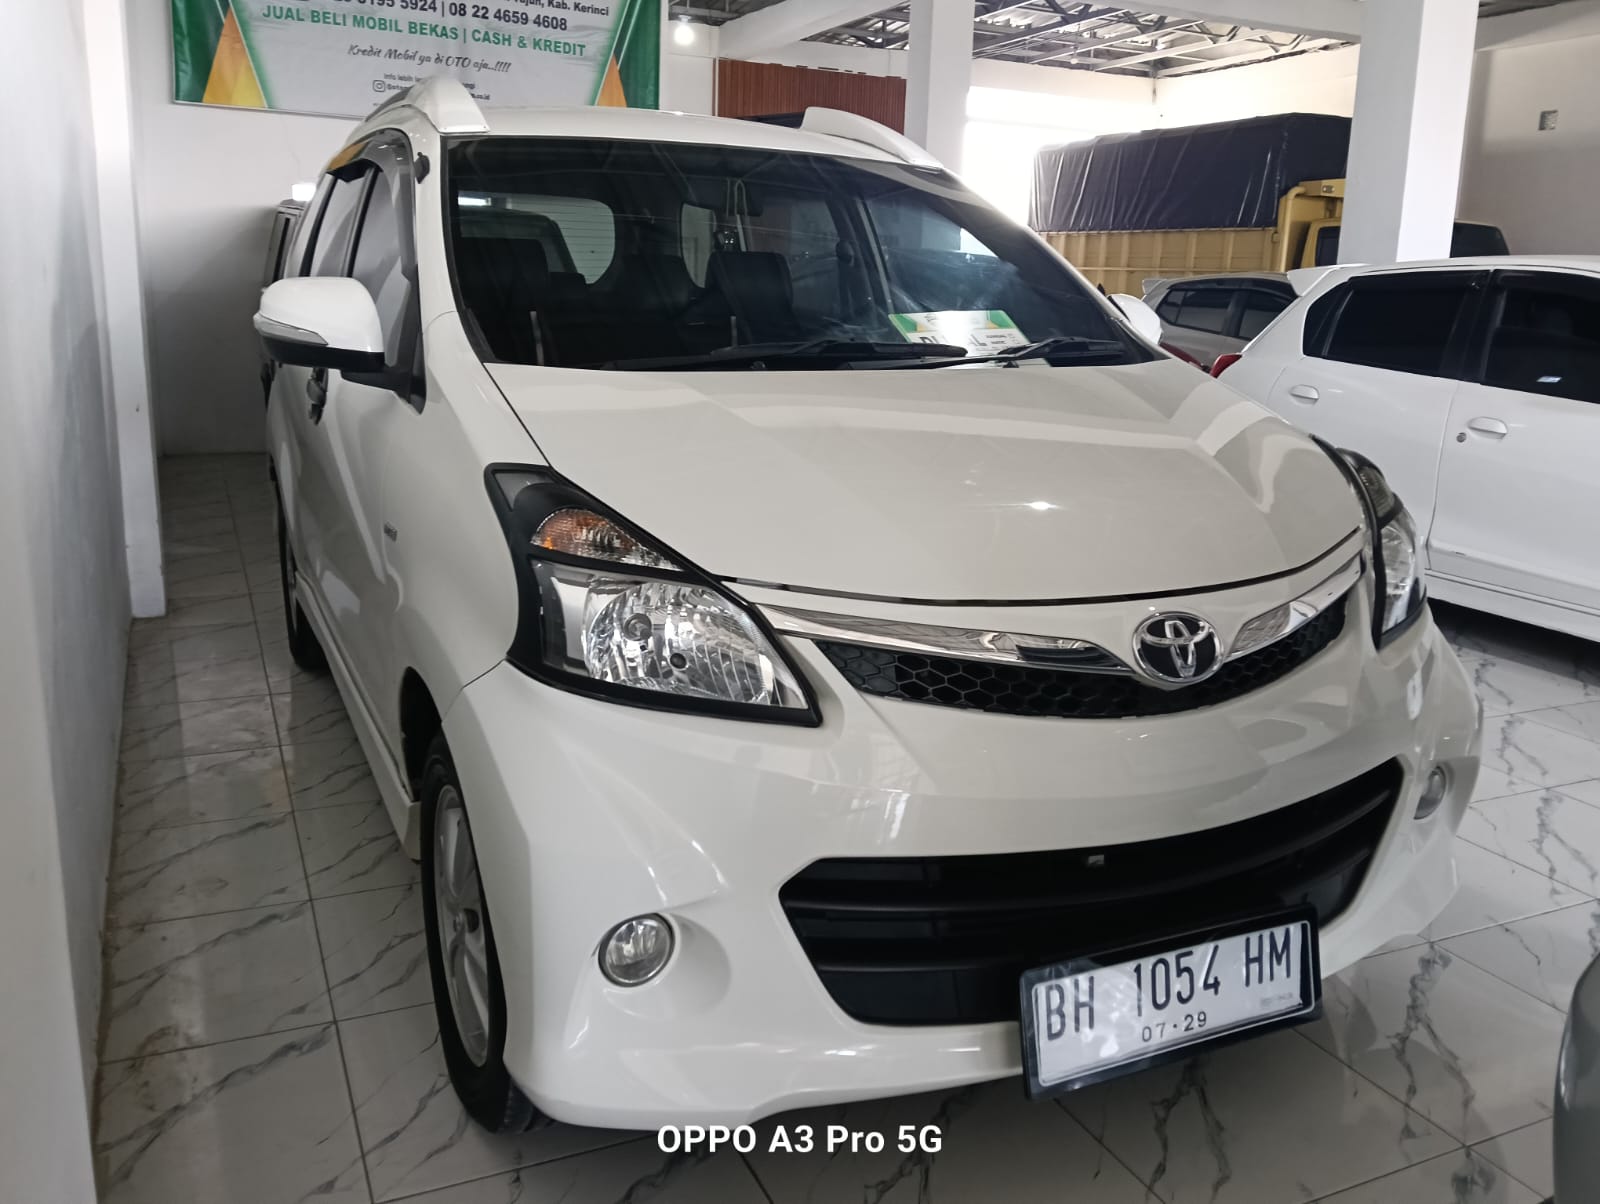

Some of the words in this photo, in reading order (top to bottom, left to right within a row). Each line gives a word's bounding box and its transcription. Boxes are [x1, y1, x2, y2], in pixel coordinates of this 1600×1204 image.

[400, 0, 437, 13] 5924
[449, 2, 467, 17] 08
[471, 5, 489, 20] 22
[493, 8, 529, 25] 4659
[533, 14, 568, 31] 4608
[547, 0, 571, 10] Kab.
[573, 2, 609, 16] Kerinci
[262, 5, 305, 22] JUAL
[310, 10, 347, 27] BELI
[352, 15, 403, 33] MOBIL
[408, 21, 459, 40] BEKAS
[471, 29, 512, 47] CASH
[517, 36, 528, 49] &
[533, 38, 586, 57] KREDIT
[347, 44, 382, 57] Kredit
[384, 48, 418, 61] Mobil
[417, 55, 432, 66] ya
[434, 53, 444, 65] di
[445, 56, 472, 68] OTO
[1045, 975, 1094, 1041] BH
[1133, 944, 1221, 1017] 1054
[1244, 927, 1291, 987] HM
